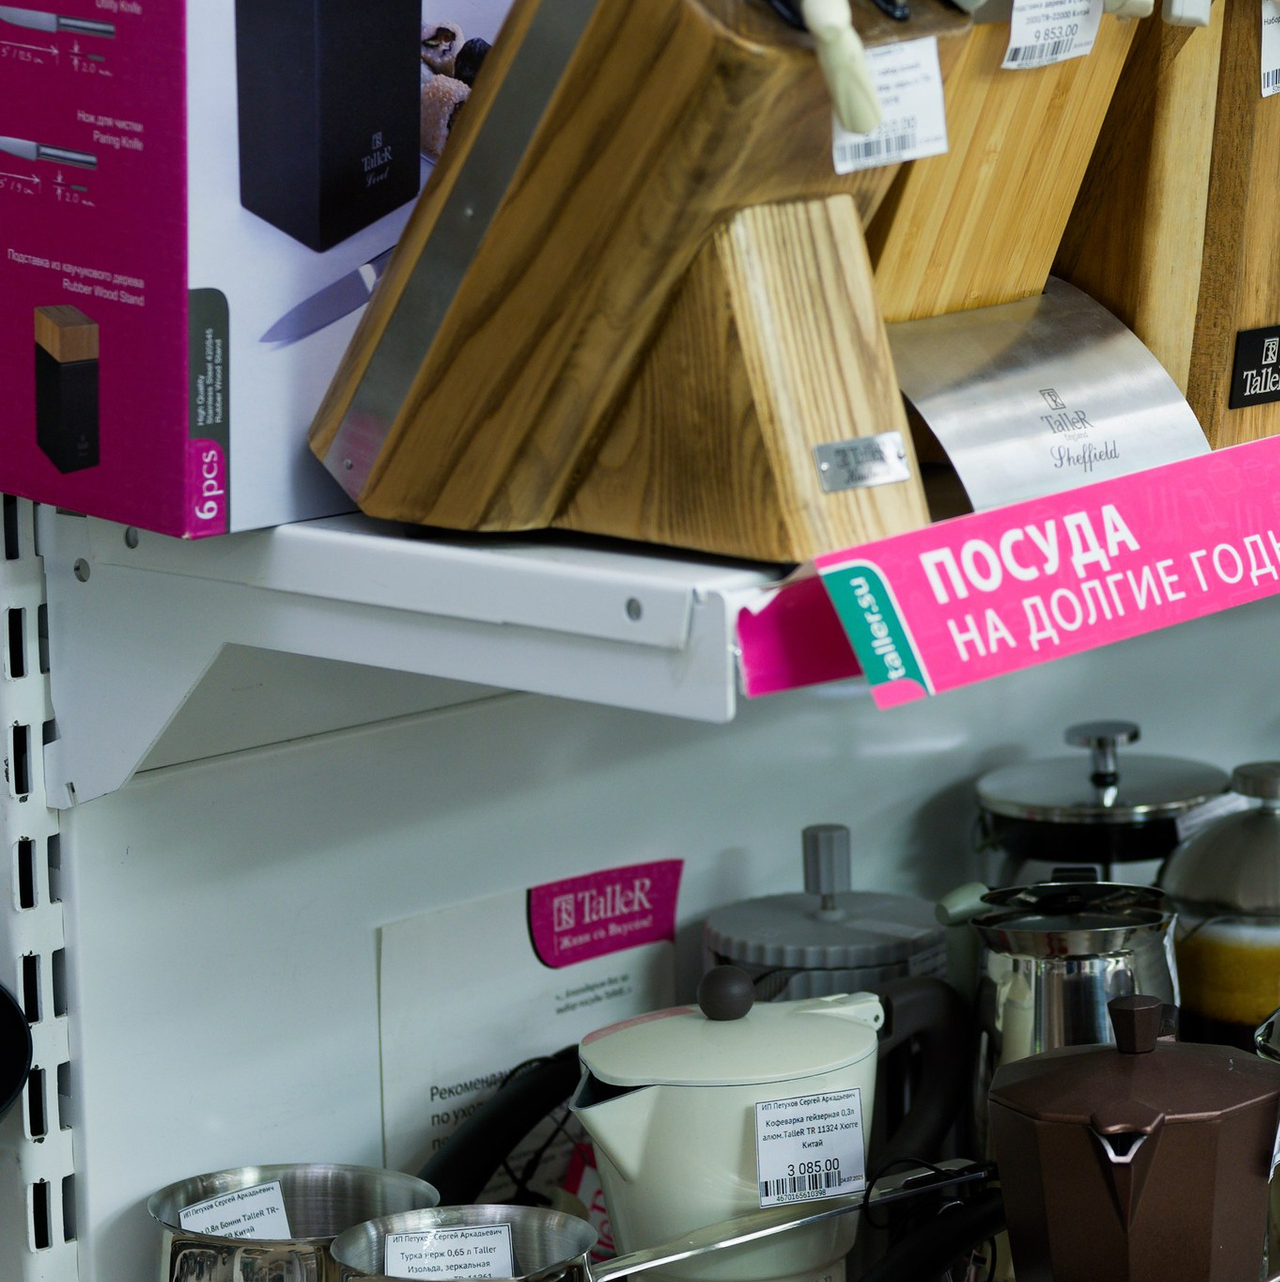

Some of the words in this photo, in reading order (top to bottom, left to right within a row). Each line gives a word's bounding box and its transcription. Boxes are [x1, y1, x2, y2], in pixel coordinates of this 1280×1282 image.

[1034, 30, 1041, 42] 9
[1043, 24, 1079, 41] 853.00
[63, 278, 92, 295] Rubber
[94, 285, 118, 300] Wood
[119, 290, 144, 306] Stand
[1040, 410, 1095, 435] TalleR
[1050, 439, 1120, 473] Sheffield
[202, 450, 224, 496] pcs
[195, 501, 218, 519] 6
[919, 504, 1141, 605] ПОСУДА
[947, 618, 1016, 662] НА
[1022, 558, 1186, 652] ДОЛГИЕ
[850, 577, 908, 681] taller.su
[577, 878, 653, 925] TalleR
[762, 1103, 772, 1111] ИП
[773, 1100, 798, 1111] Петухов
[800, 1096, 820, 1107] Сергей
[821, 1092, 856, 1104] Аркадьевич
[431, 1111, 450, 1127] по
[765, 1115, 804, 1128] Кофеварка
[806, 1111, 840, 1123] гейзерная
[841, 1108, 855, 1117] 0,3л
[807, 1127, 816, 1135] TR
[817, 1124, 838, 1134] 11324
[802, 1139, 823, 1149] Китай
[787, 1164, 795, 1177] 3
[798, 1158, 840, 1175] 085.00
[183, 1211, 191, 1219] ИП
[192, 1203, 214, 1217] Петухов
[215, 1195, 236, 1208] Сергей
[236, 1186, 275, 1200] Аркадьевич
[242, 1210, 265, 1222] TalleR
[266, 1206, 280, 1215] TR-
[233, 1226, 256, 1238] Китай
[433, 1232, 458, 1242] Сергей
[460, 1229, 503, 1239] Аркадьевич
[400, 1252, 422, 1262] Турка
[447, 1249, 465, 1258] 0,65
[474, 1245, 497, 1255] Taller
[408, 1265, 443, 1274] Изольда,
[445, 1260, 491, 1272] зеркальная
